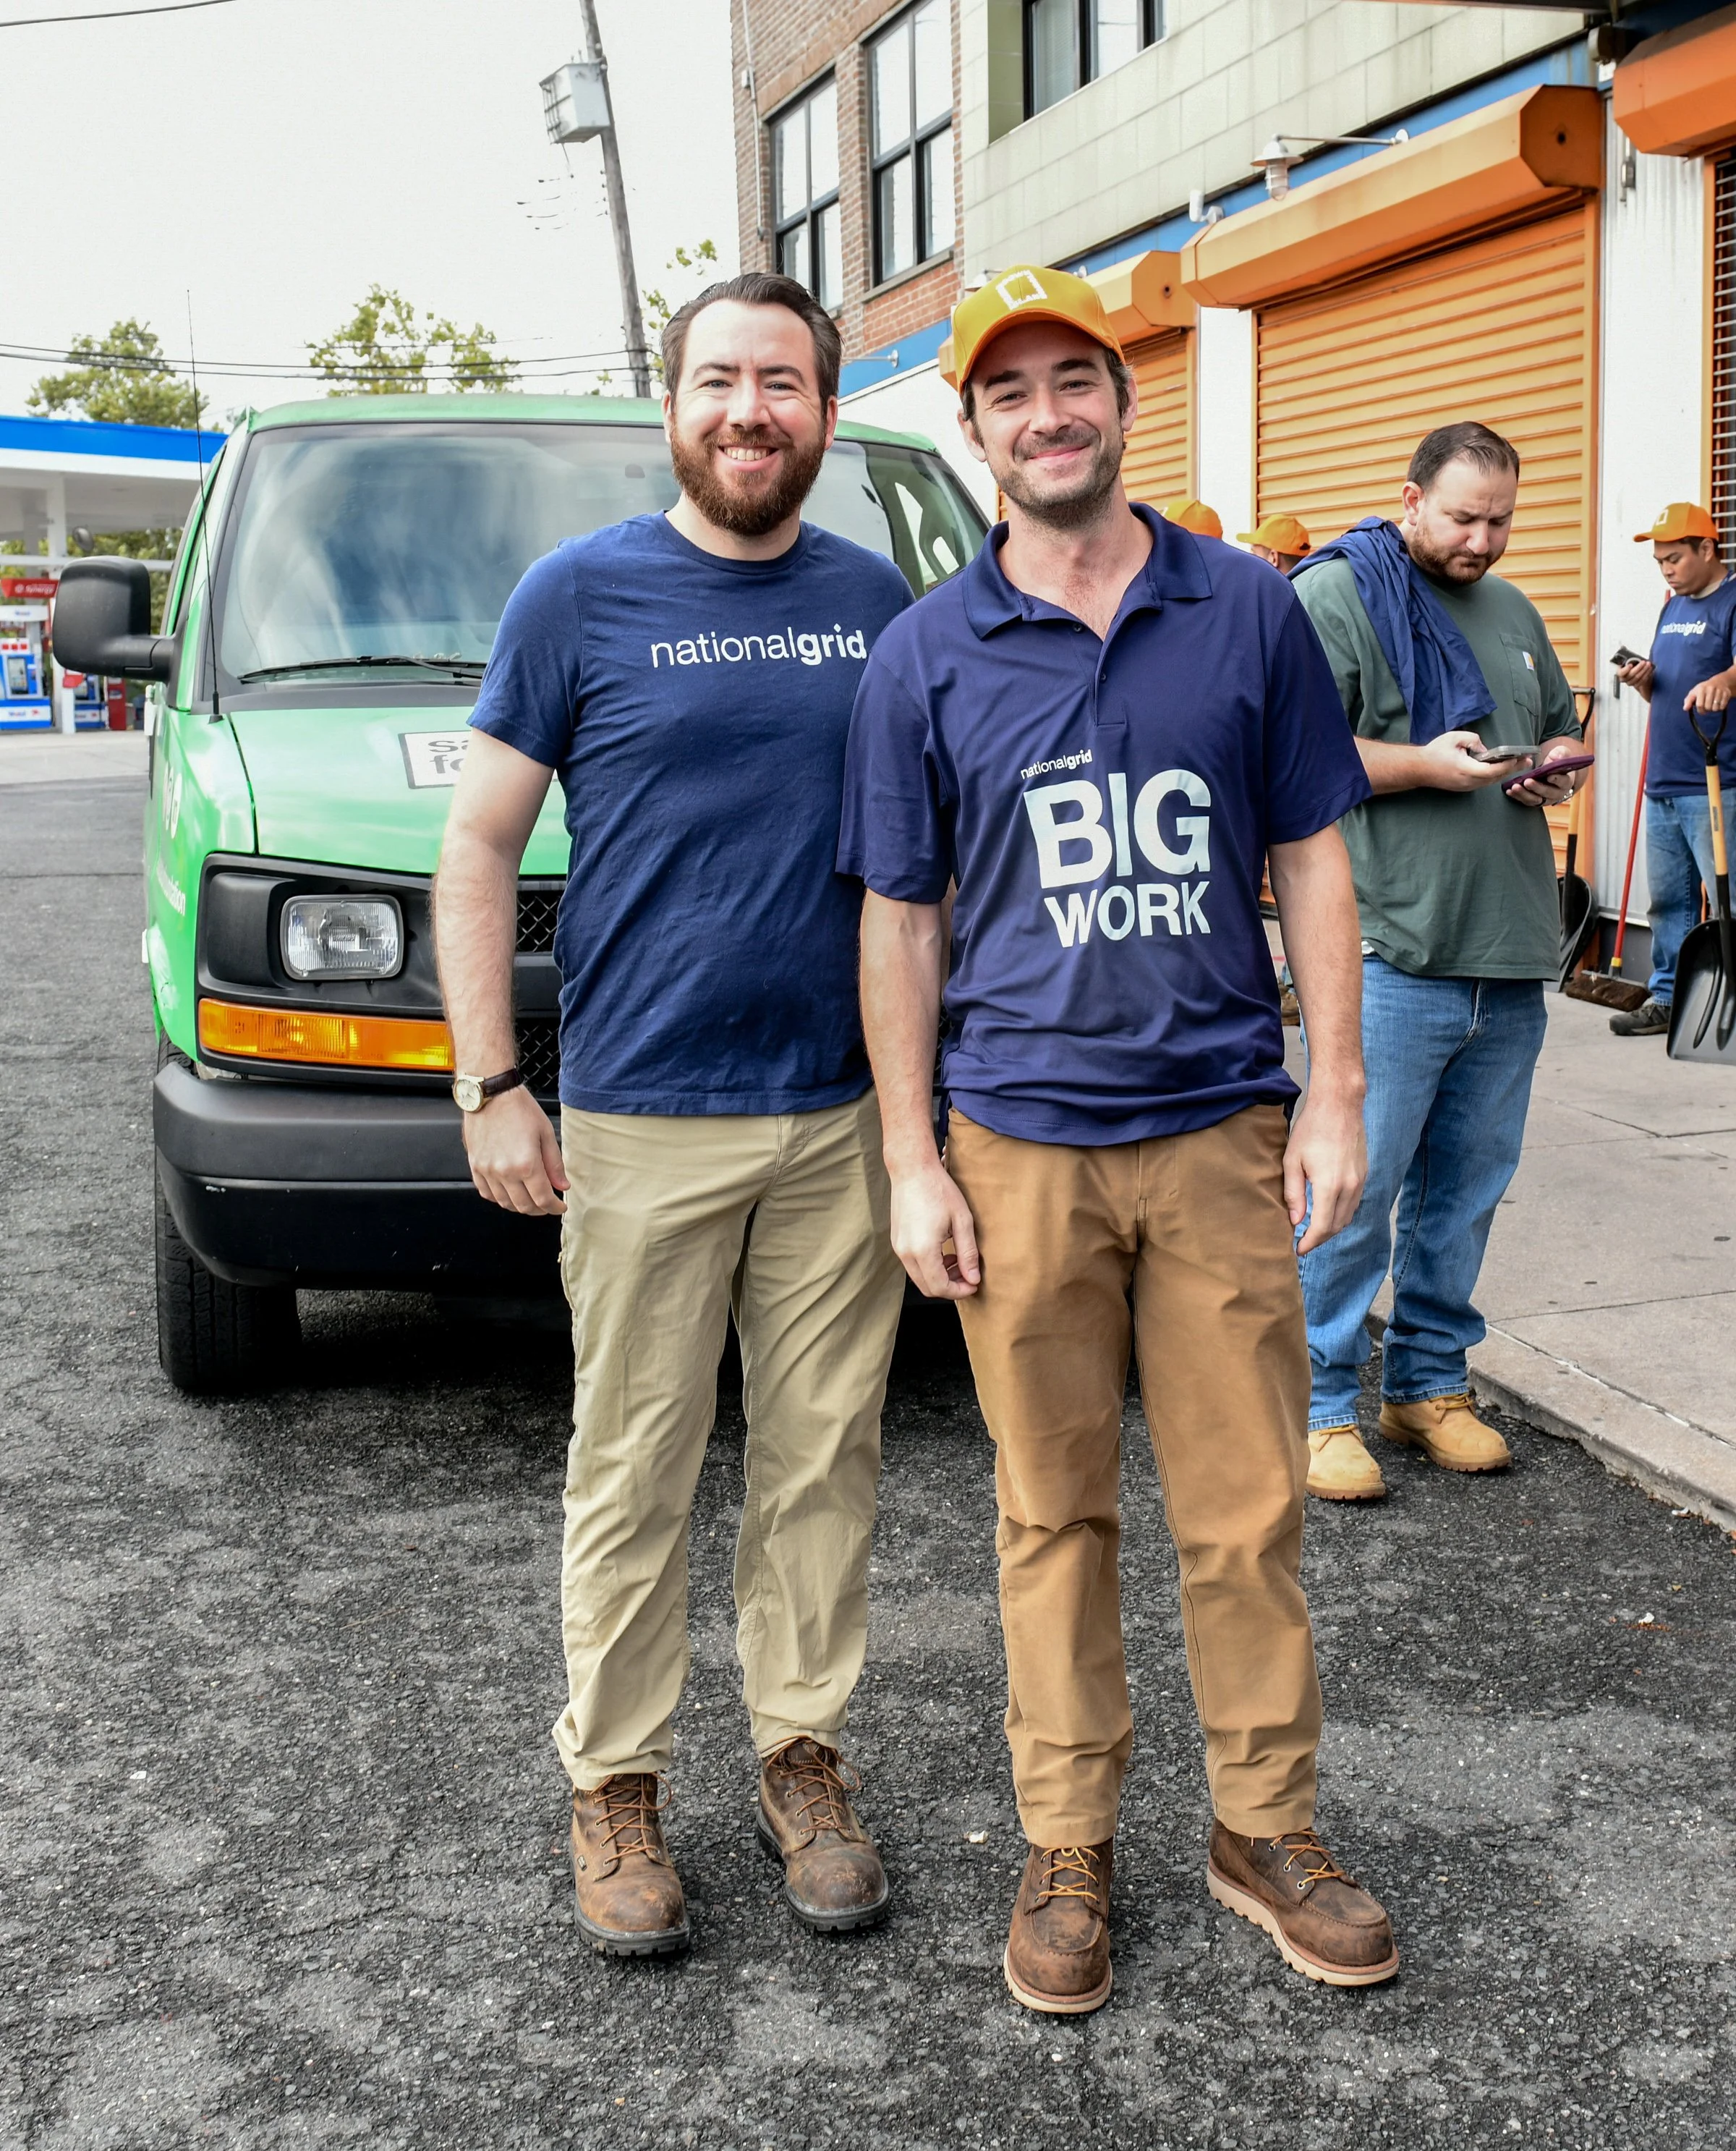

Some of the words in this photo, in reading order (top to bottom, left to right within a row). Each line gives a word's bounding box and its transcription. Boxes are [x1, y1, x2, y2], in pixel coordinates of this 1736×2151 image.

[651, 623, 867, 668] nationalgrid
[1020, 749, 1093, 779] nationalgrid
[1024, 769, 1212, 888] BIG
[1044, 881, 1211, 948] WORK
